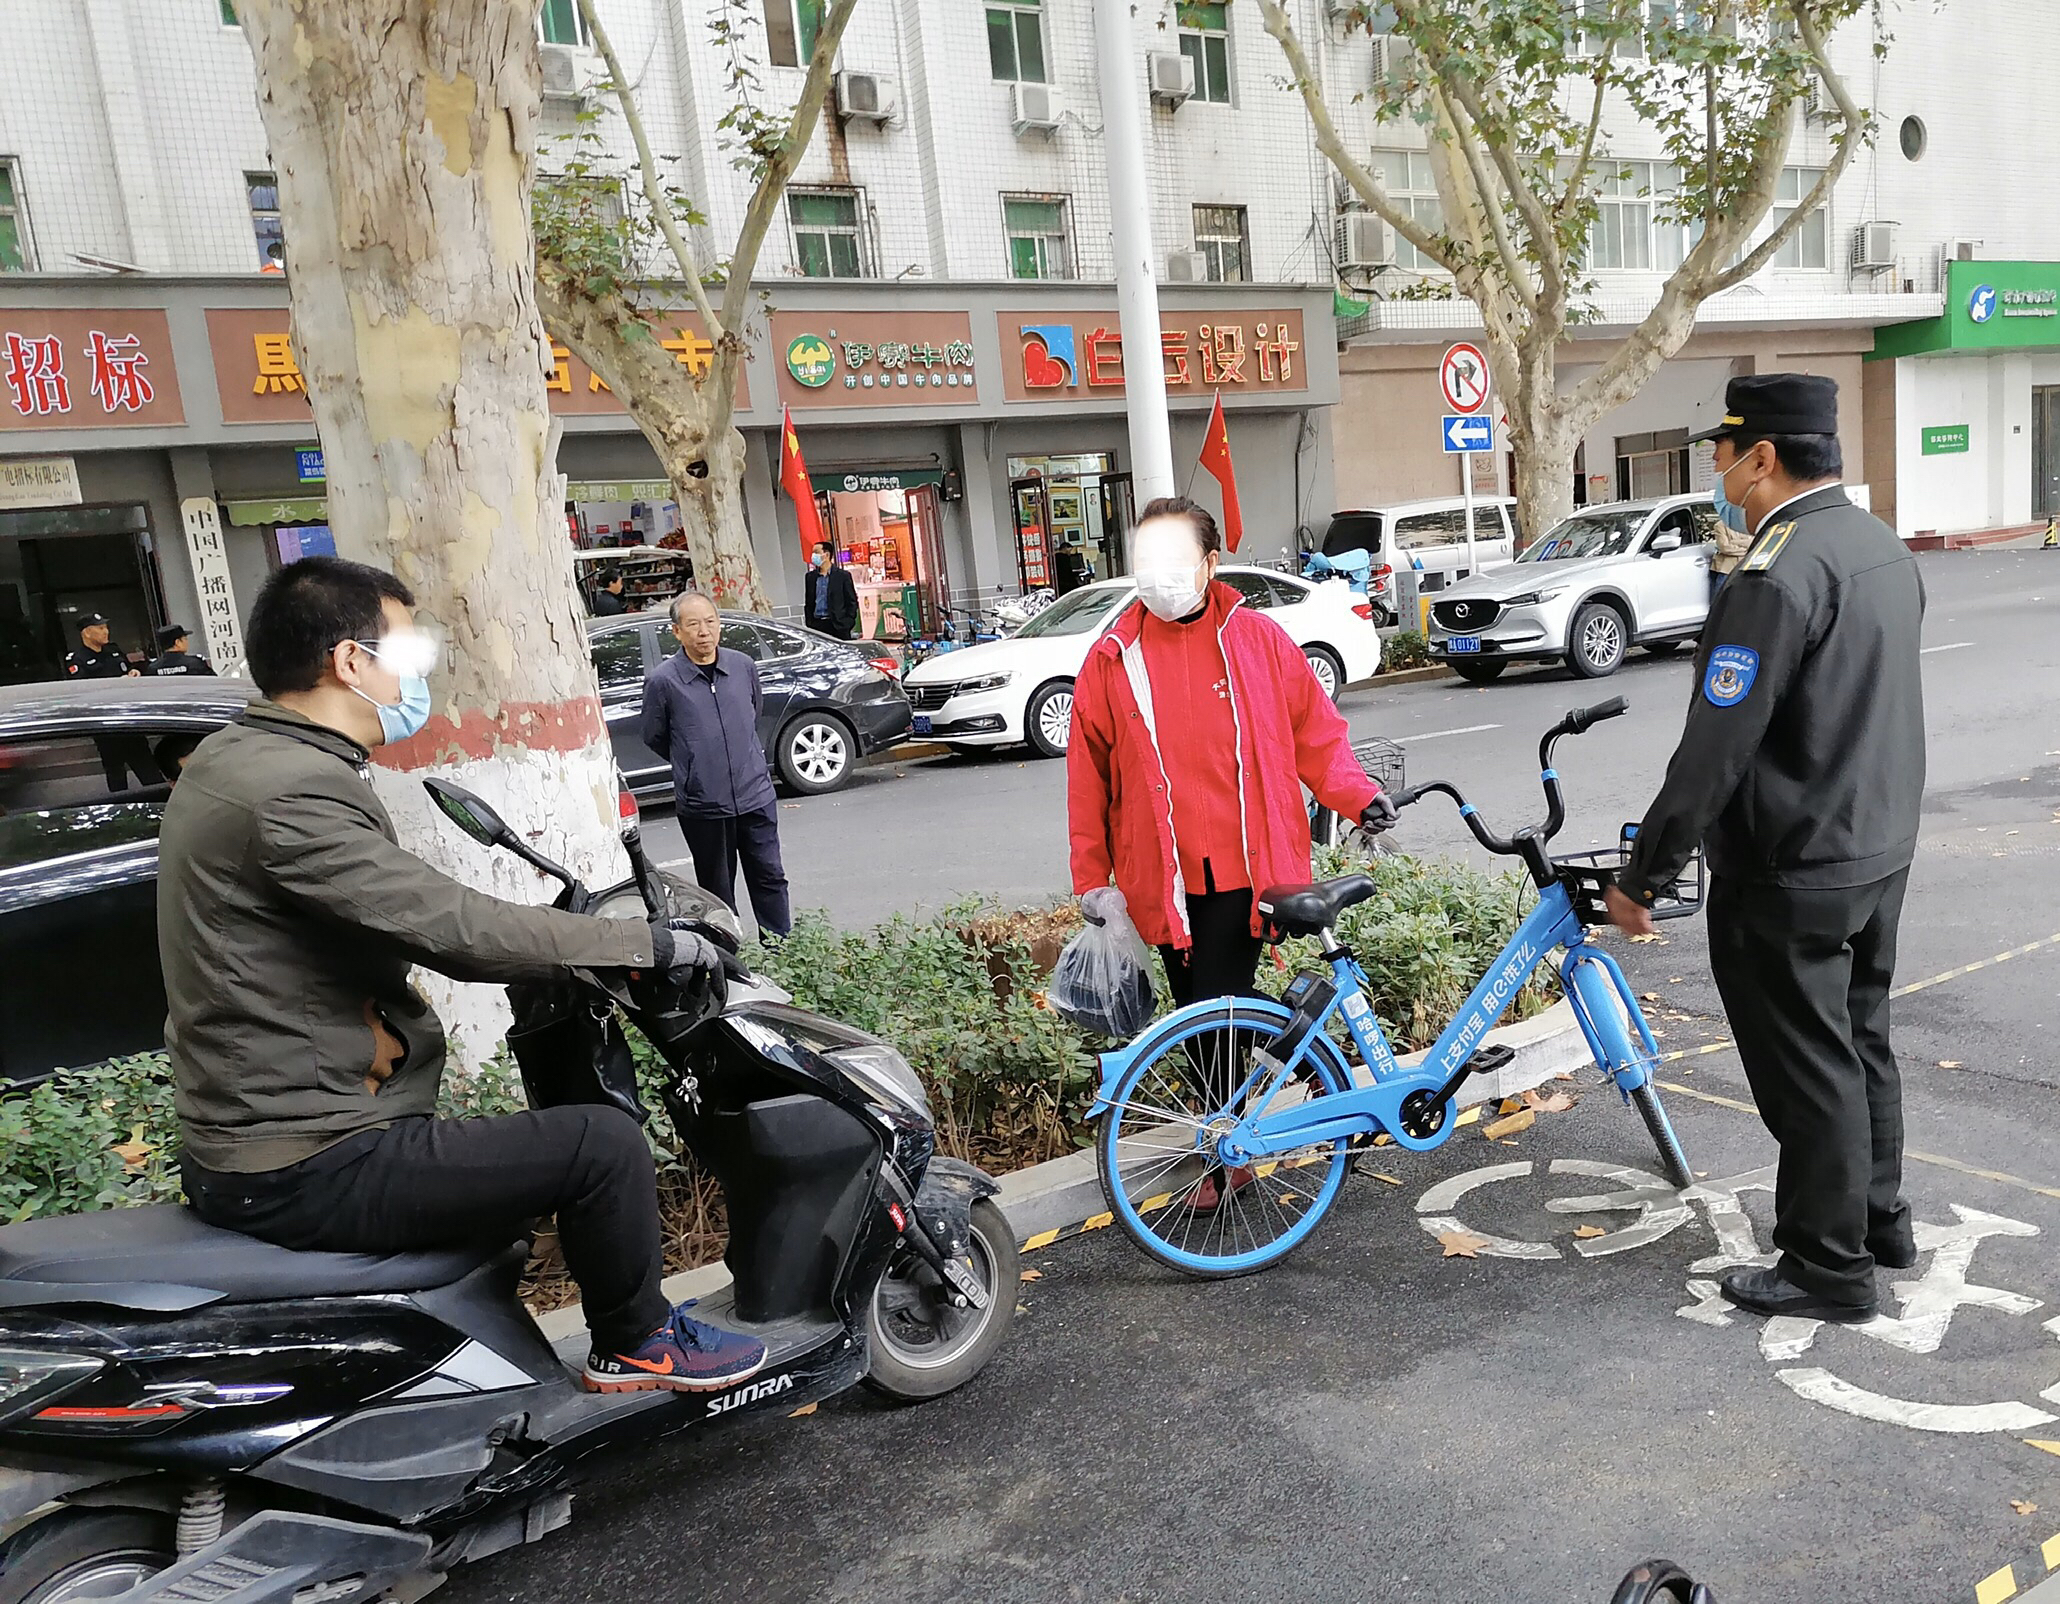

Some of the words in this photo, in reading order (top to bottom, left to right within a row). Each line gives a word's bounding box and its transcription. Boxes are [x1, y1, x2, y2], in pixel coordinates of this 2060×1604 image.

[3, 331, 154, 415] 招标
[1083, 324, 1299, 386] 白云设计
[1439, 1010, 1487, 1078] 上支付宝
[590, 1353, 621, 1374] AIR
[705, 1373, 795, 1418] SUNRA
